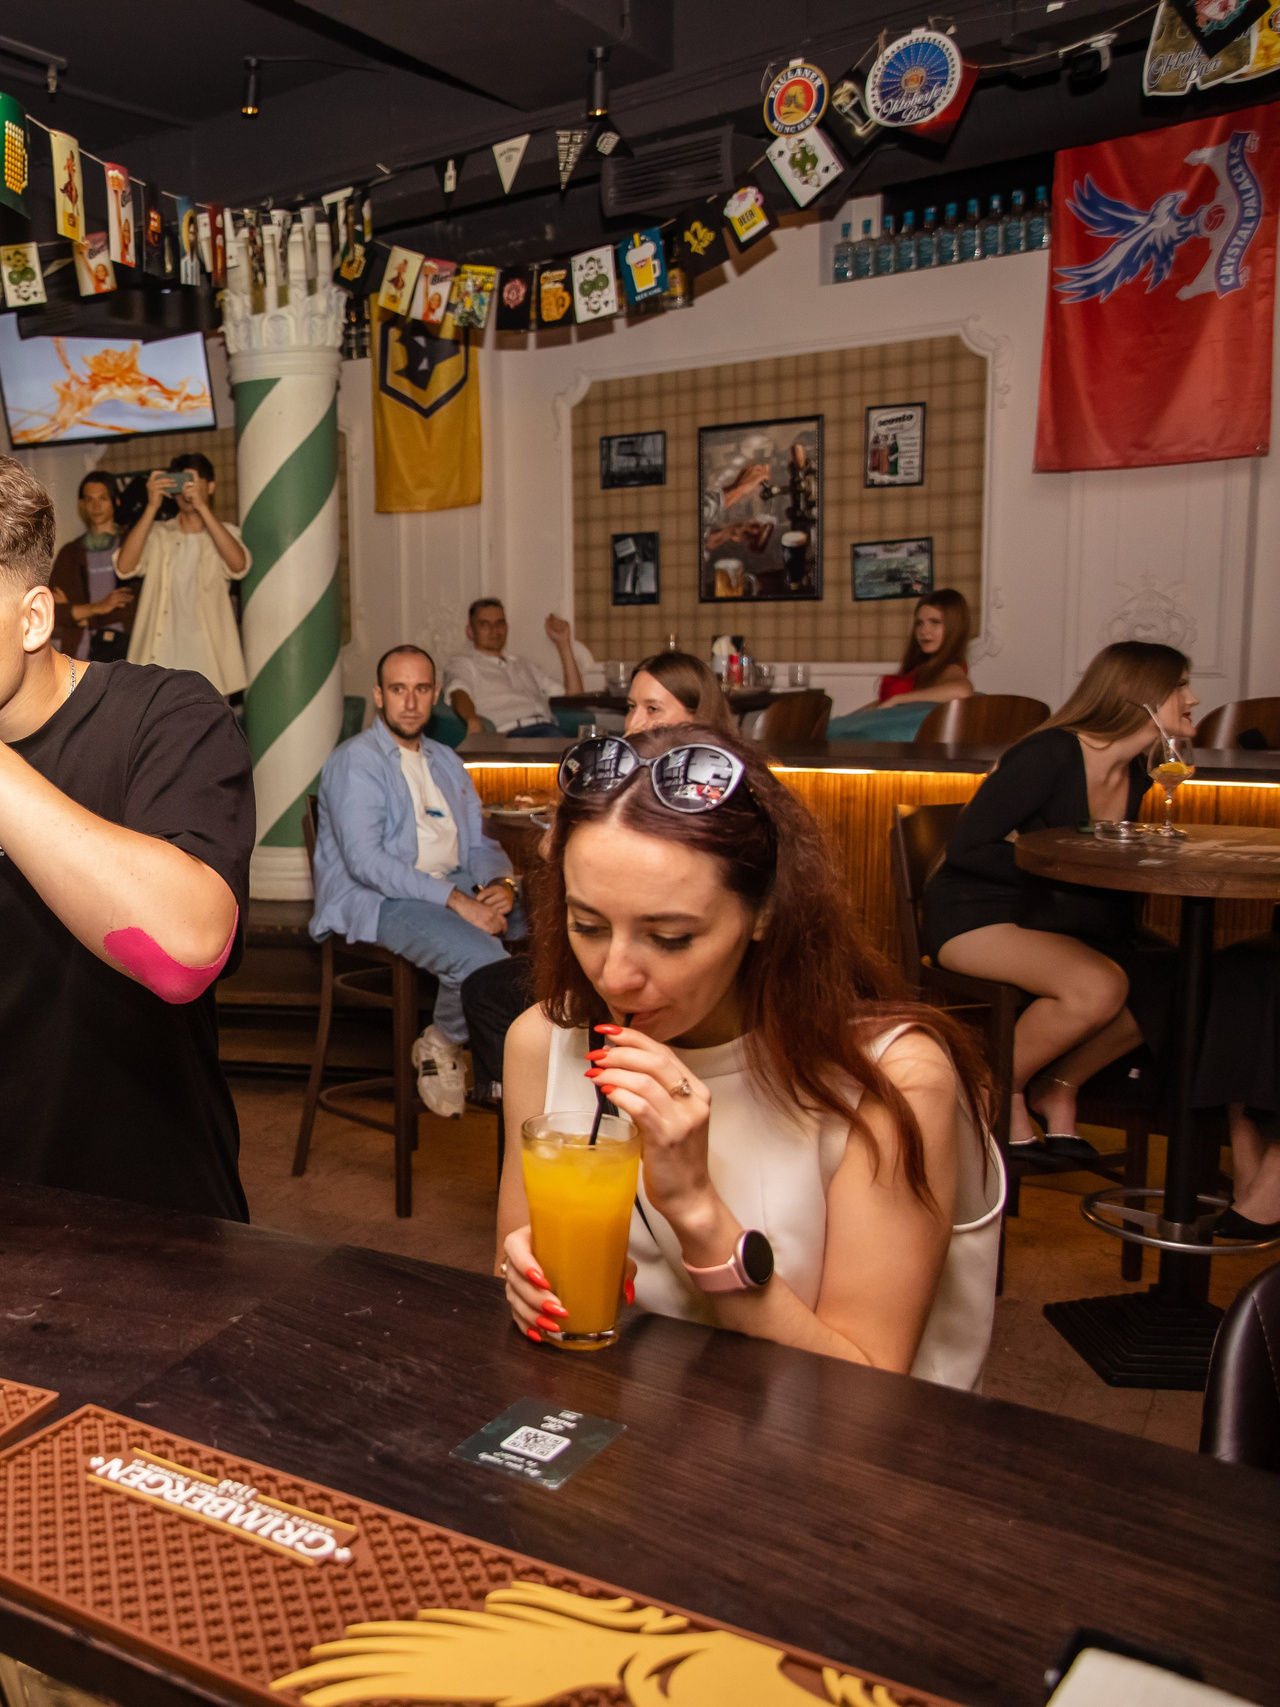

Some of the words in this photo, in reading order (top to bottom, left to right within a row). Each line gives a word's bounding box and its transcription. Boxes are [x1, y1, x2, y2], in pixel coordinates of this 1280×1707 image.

[769, 66, 823, 99] PAULANER
[900, 107, 931, 123] Bier
[1229, 165, 1258, 217] PALACE
[737, 209, 756, 227] BEER
[1219, 217, 1256, 287] CRYSTAL
[218, 1479, 259, 1499] 1128
[96, 1457, 338, 1557] GRIMBERGEN
